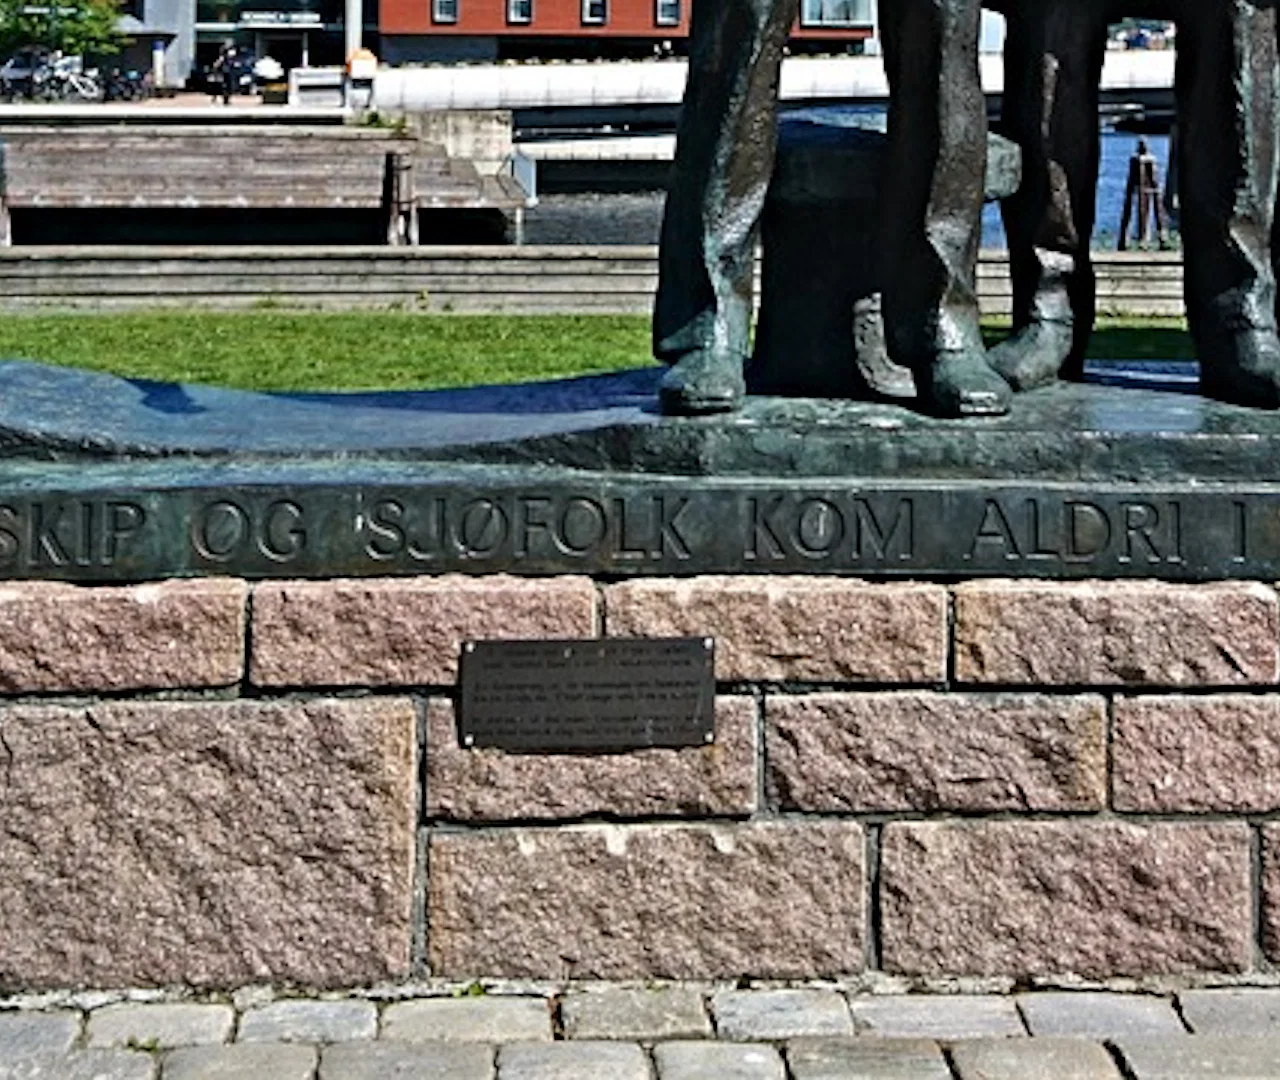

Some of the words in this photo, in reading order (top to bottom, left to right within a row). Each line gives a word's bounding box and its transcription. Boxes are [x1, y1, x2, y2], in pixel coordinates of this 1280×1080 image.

[190, 499, 308, 562] OG
[363, 498, 692, 561] SJØFOLK
[743, 496, 914, 561] KOM
[963, 497, 1186, 565] ALDRI
[1232, 500, 1247, 563] I
